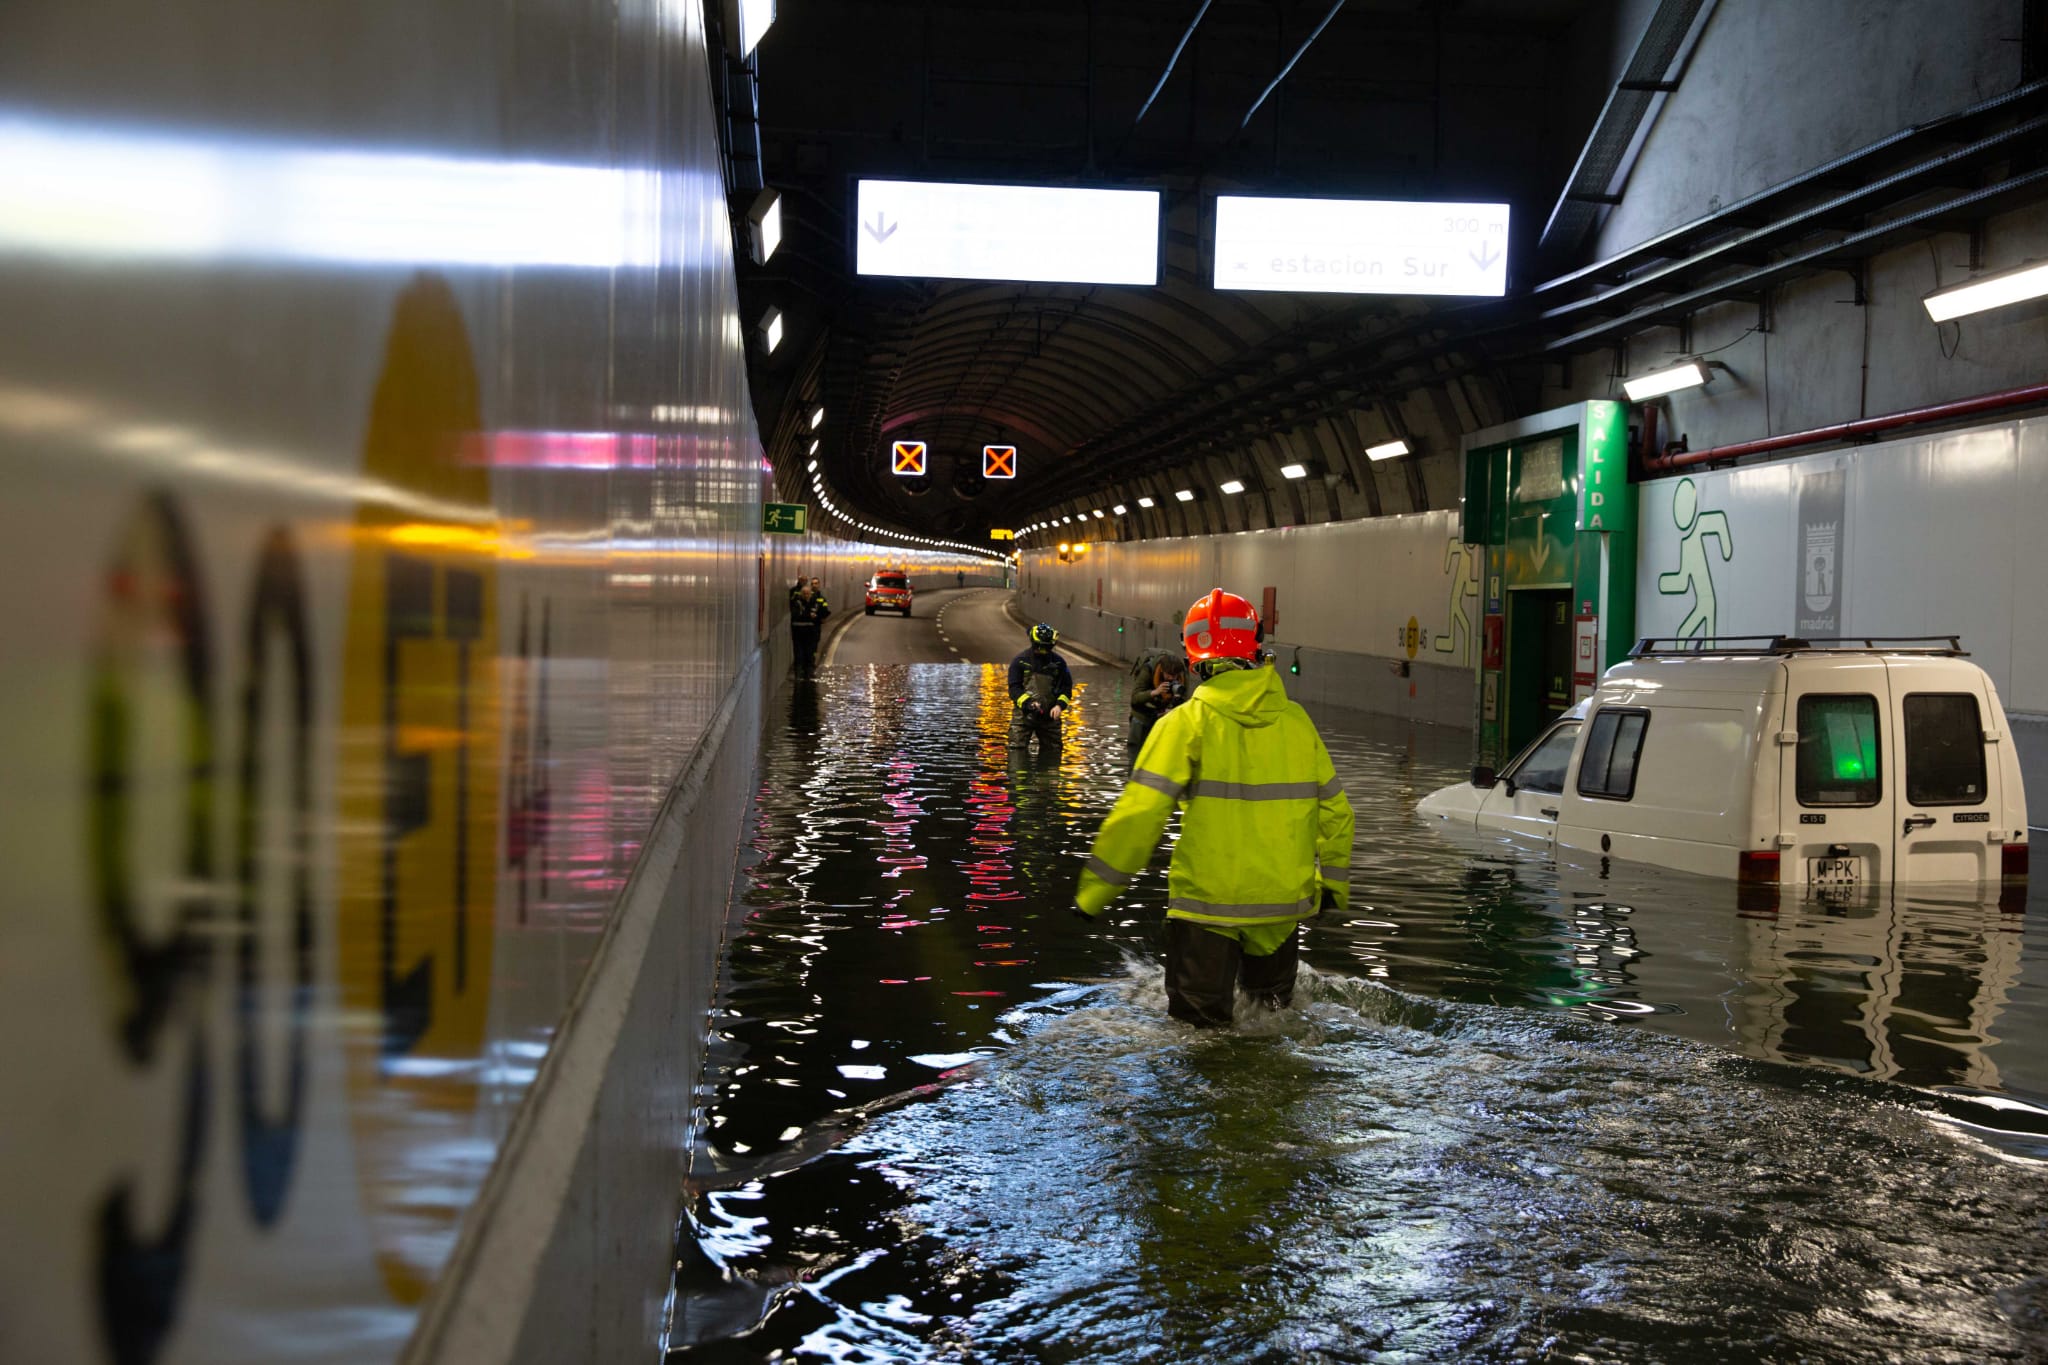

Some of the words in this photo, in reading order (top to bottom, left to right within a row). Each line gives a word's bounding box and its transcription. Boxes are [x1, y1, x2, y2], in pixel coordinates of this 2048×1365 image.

[1442, 216, 1480, 233] 300
[1488, 221, 1504, 233] m
[1403, 255, 1449, 278] Sur
[1590, 404, 1607, 528] SALIDA
[1800, 616, 1835, 631] madrid
[1954, 813, 1990, 822] CITROEN
[1817, 860, 1854, 878] M-PK
